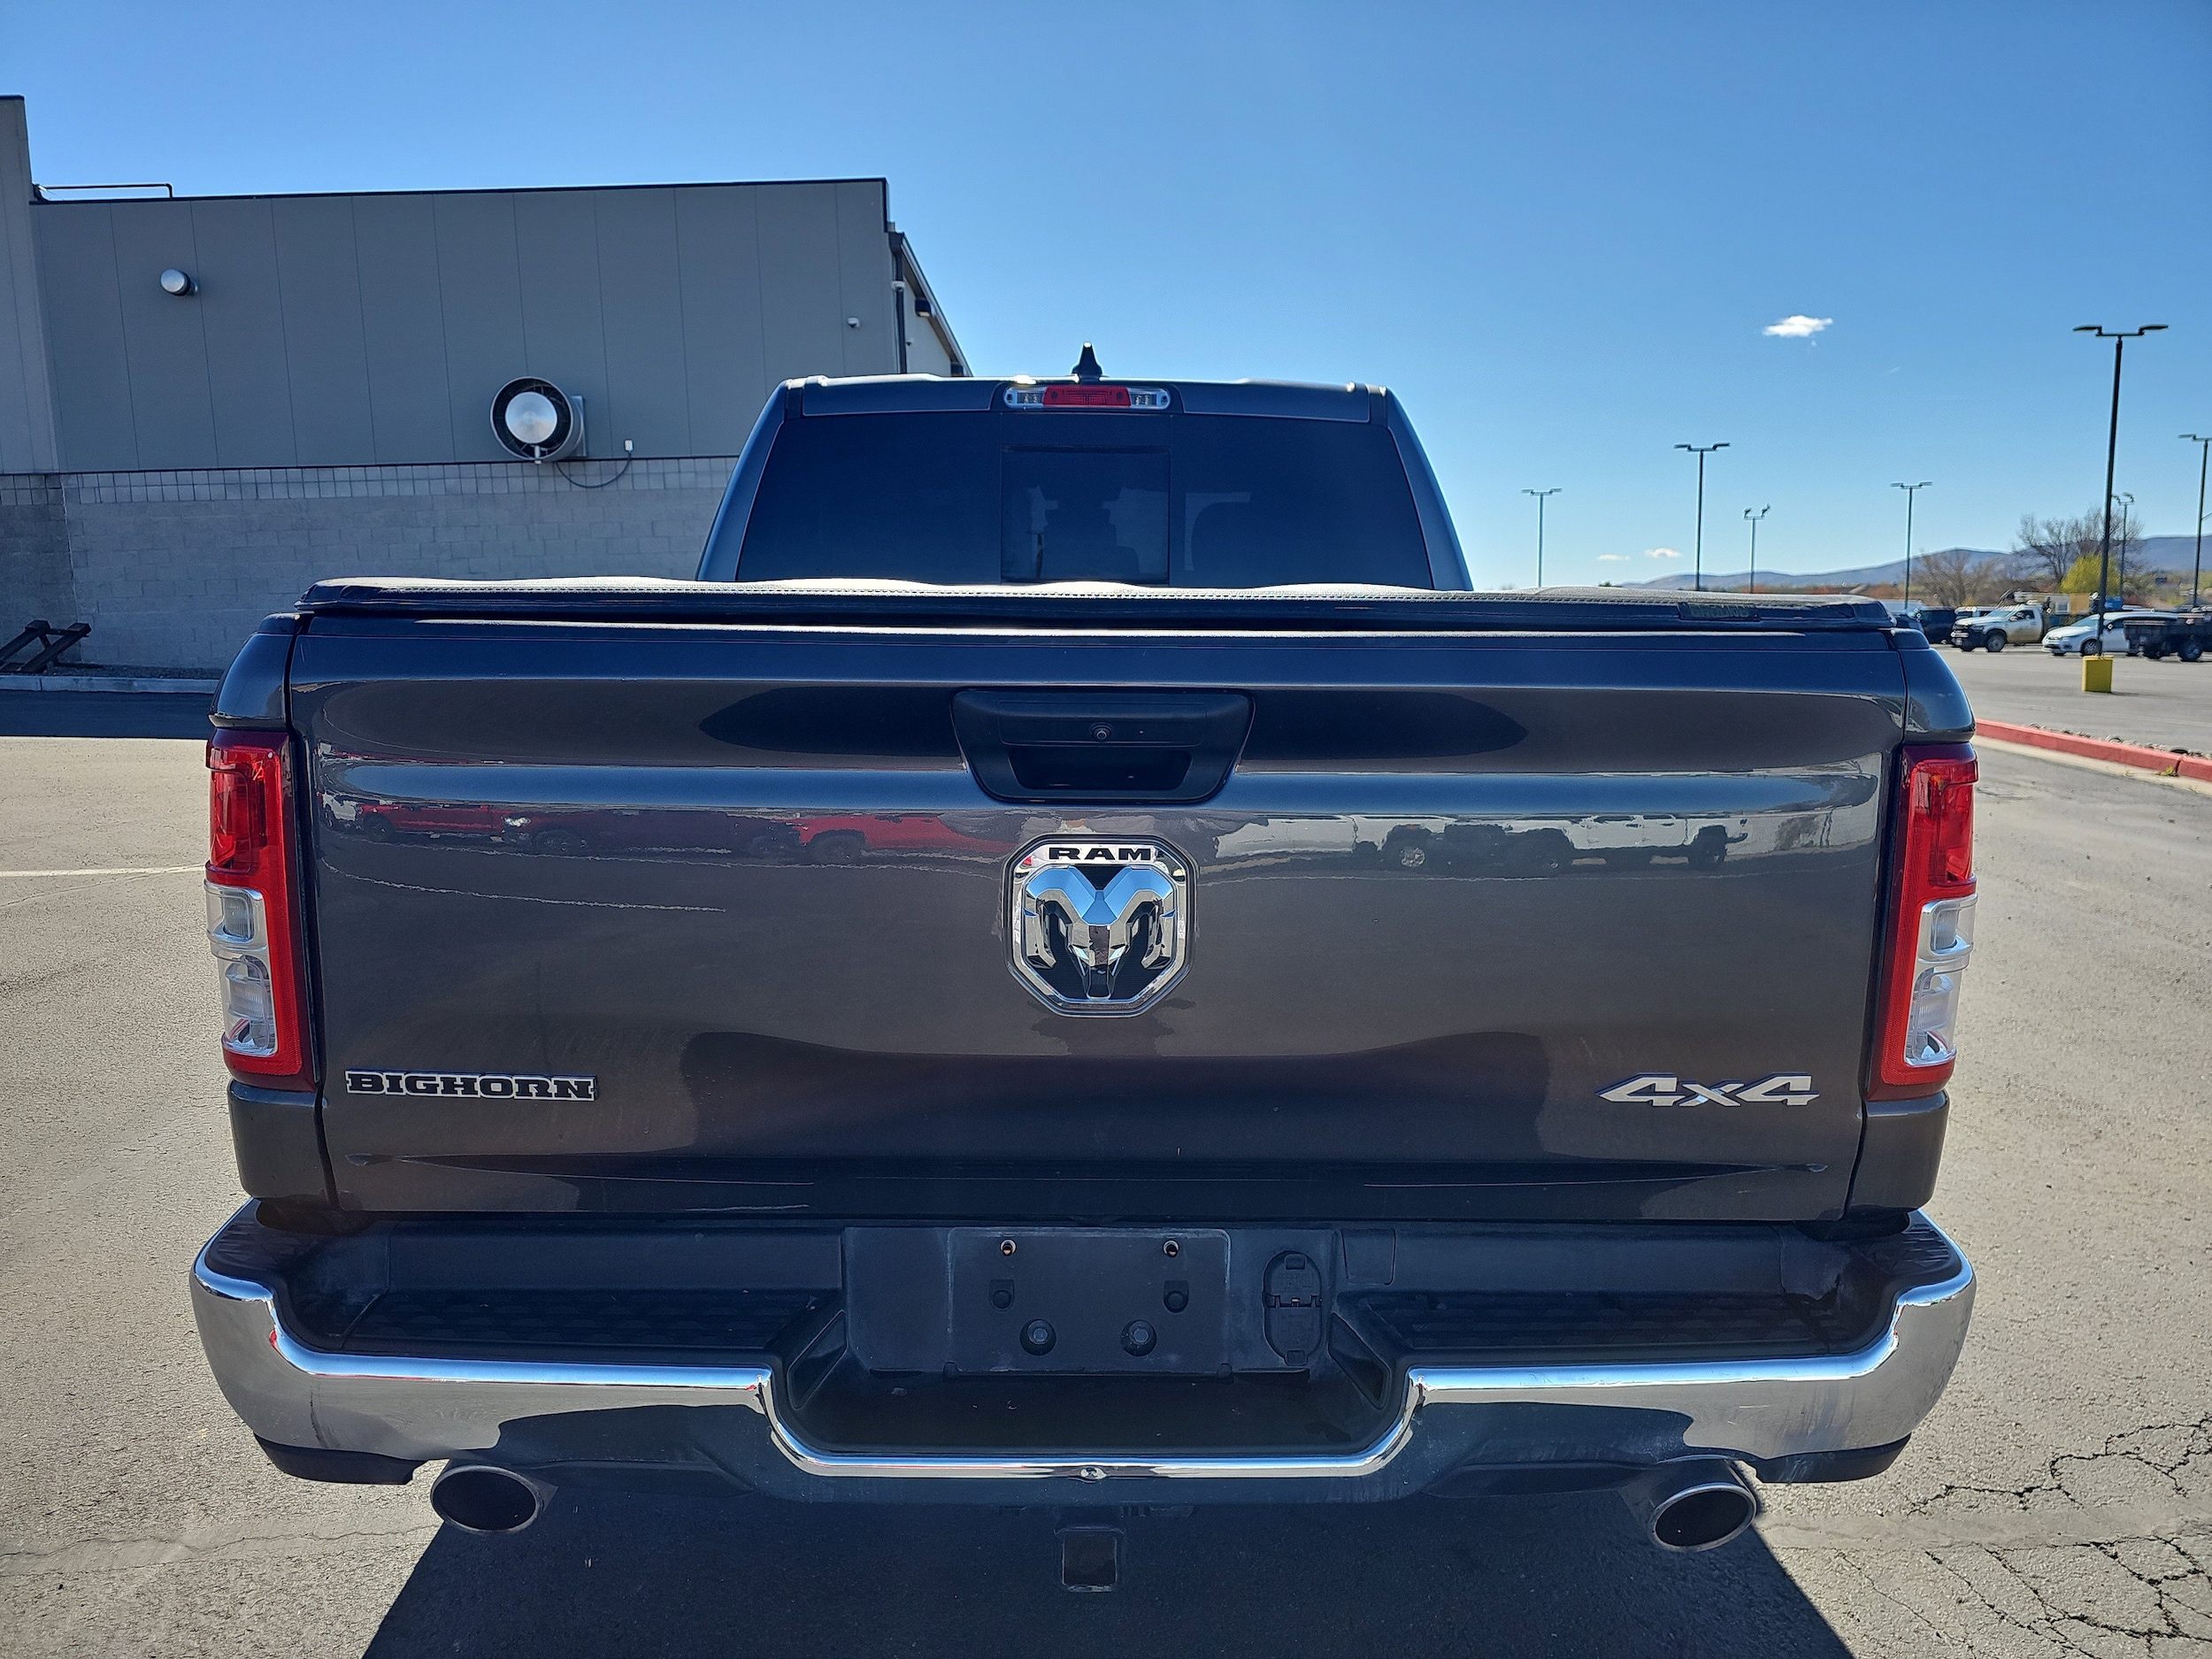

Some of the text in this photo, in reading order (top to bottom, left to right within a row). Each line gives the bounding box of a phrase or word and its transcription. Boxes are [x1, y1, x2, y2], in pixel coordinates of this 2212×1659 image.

[1048, 847, 1152, 861] RAM
[344, 1069, 598, 1102] BIGHORN
[1596, 1073, 1820, 1107] 4x4
